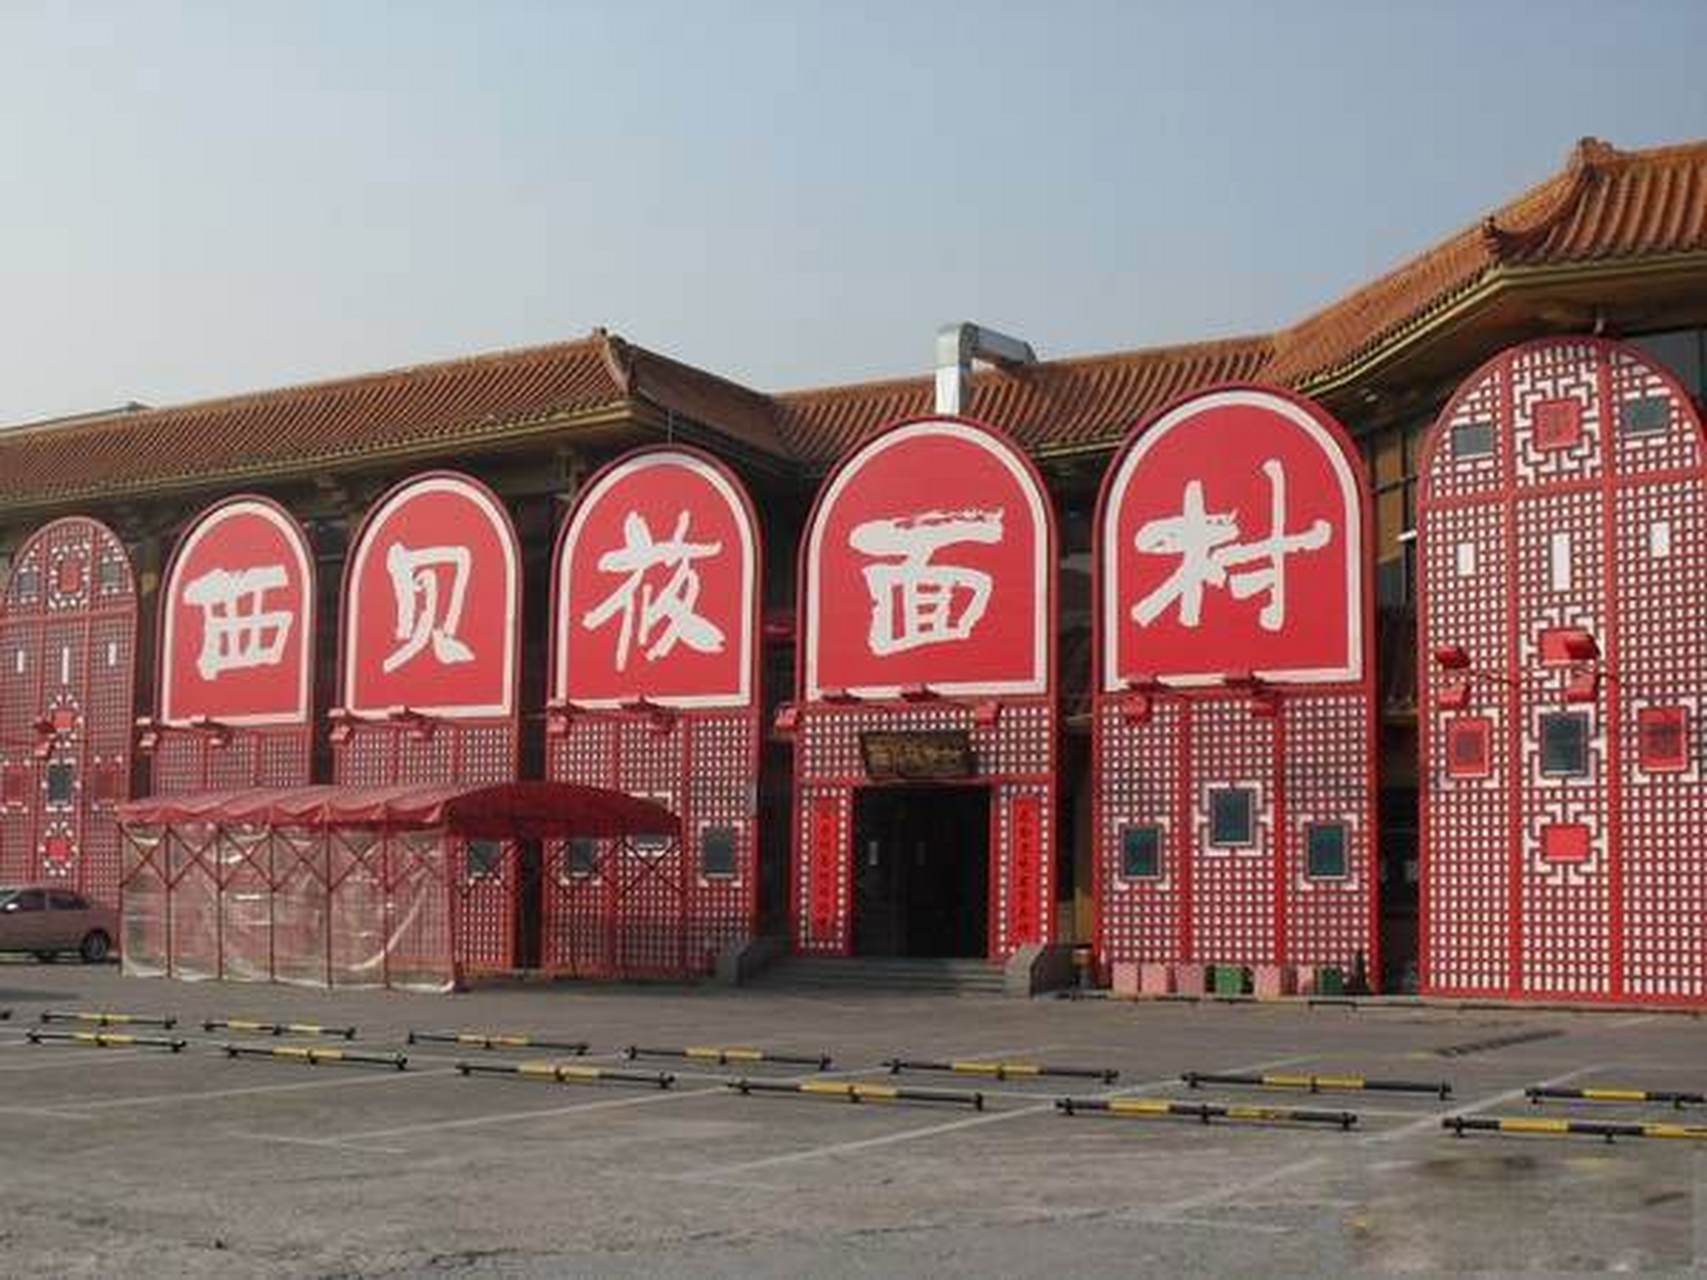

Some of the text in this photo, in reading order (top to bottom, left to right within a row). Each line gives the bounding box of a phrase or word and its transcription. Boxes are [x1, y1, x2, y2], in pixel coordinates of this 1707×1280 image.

[182, 459, 1332, 680] 西贝莜面村
